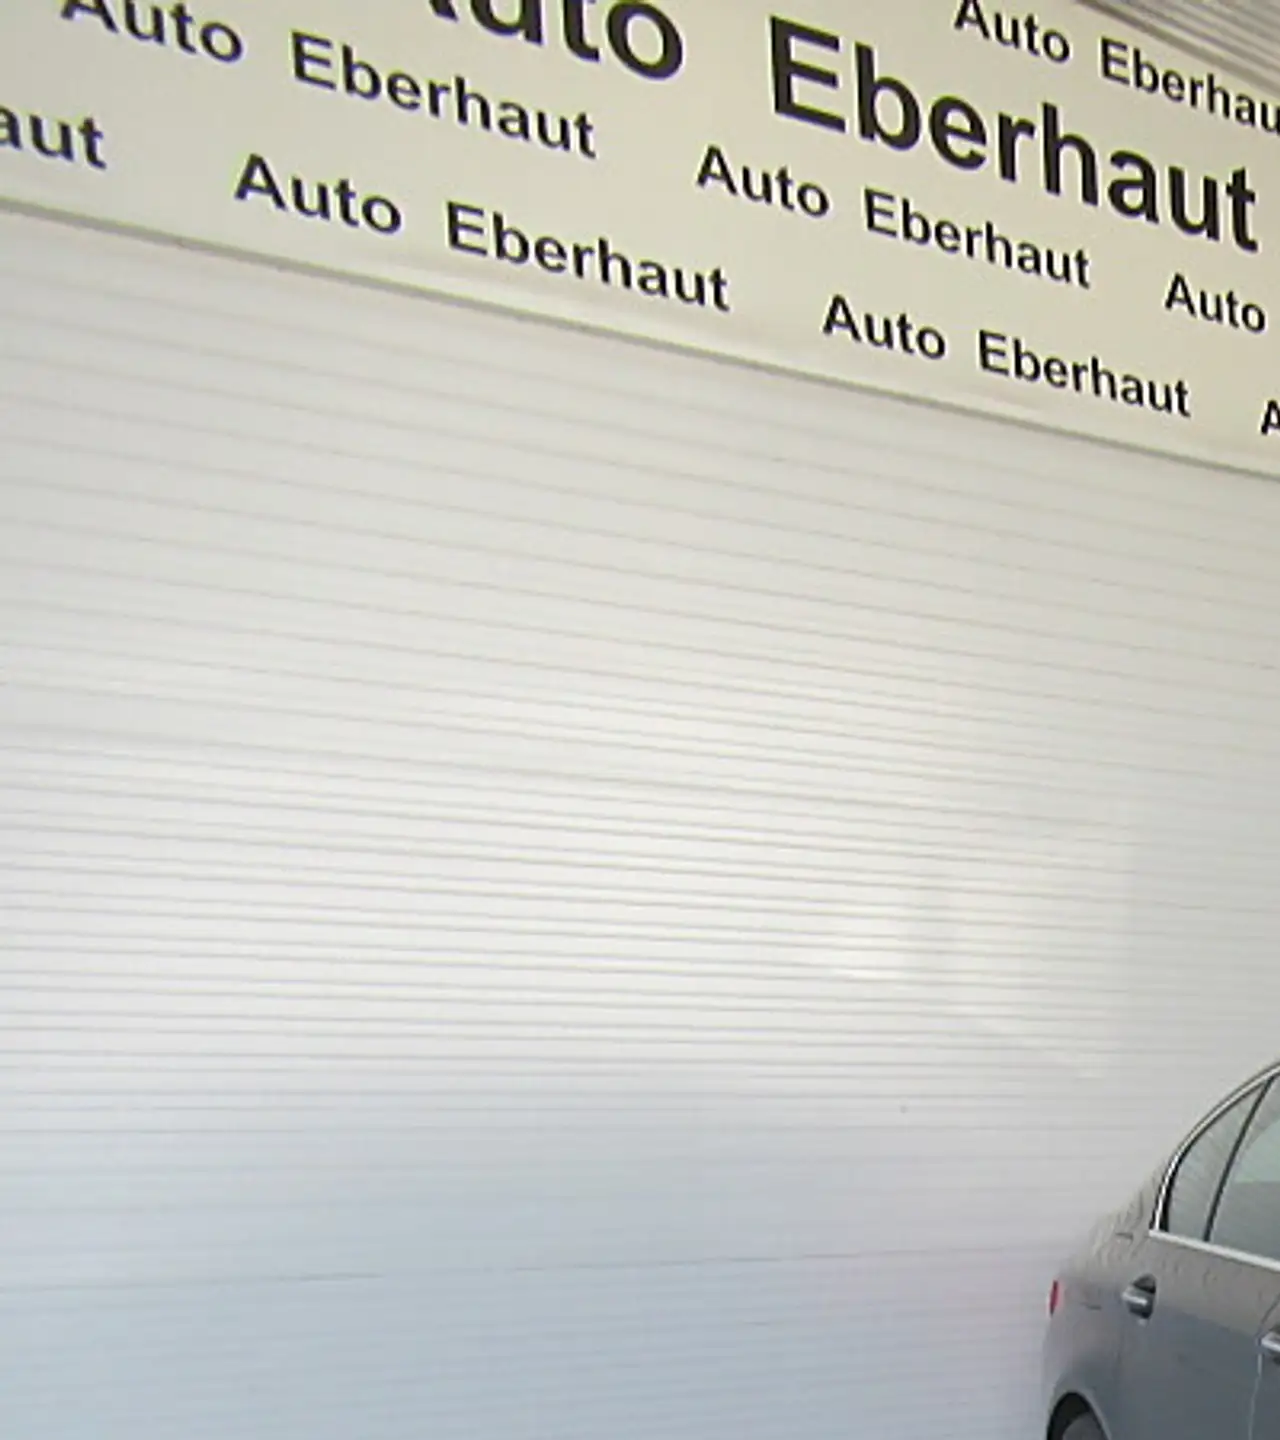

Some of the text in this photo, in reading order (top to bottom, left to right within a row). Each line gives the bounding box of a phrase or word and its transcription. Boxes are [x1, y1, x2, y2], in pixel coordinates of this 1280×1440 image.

[62, 0, 599, 157] Auto Eberhaut
[955, 0, 1069, 62] Auto
[429, 0, 1258, 252] uto Eberhaut
[236, 154, 728, 311] Auto Eberhaut
[698, 146, 1090, 288] Auto Eberhaut
[824, 295, 1189, 417] Auto Eberhaut
[1166, 274, 1264, 332] Auto
